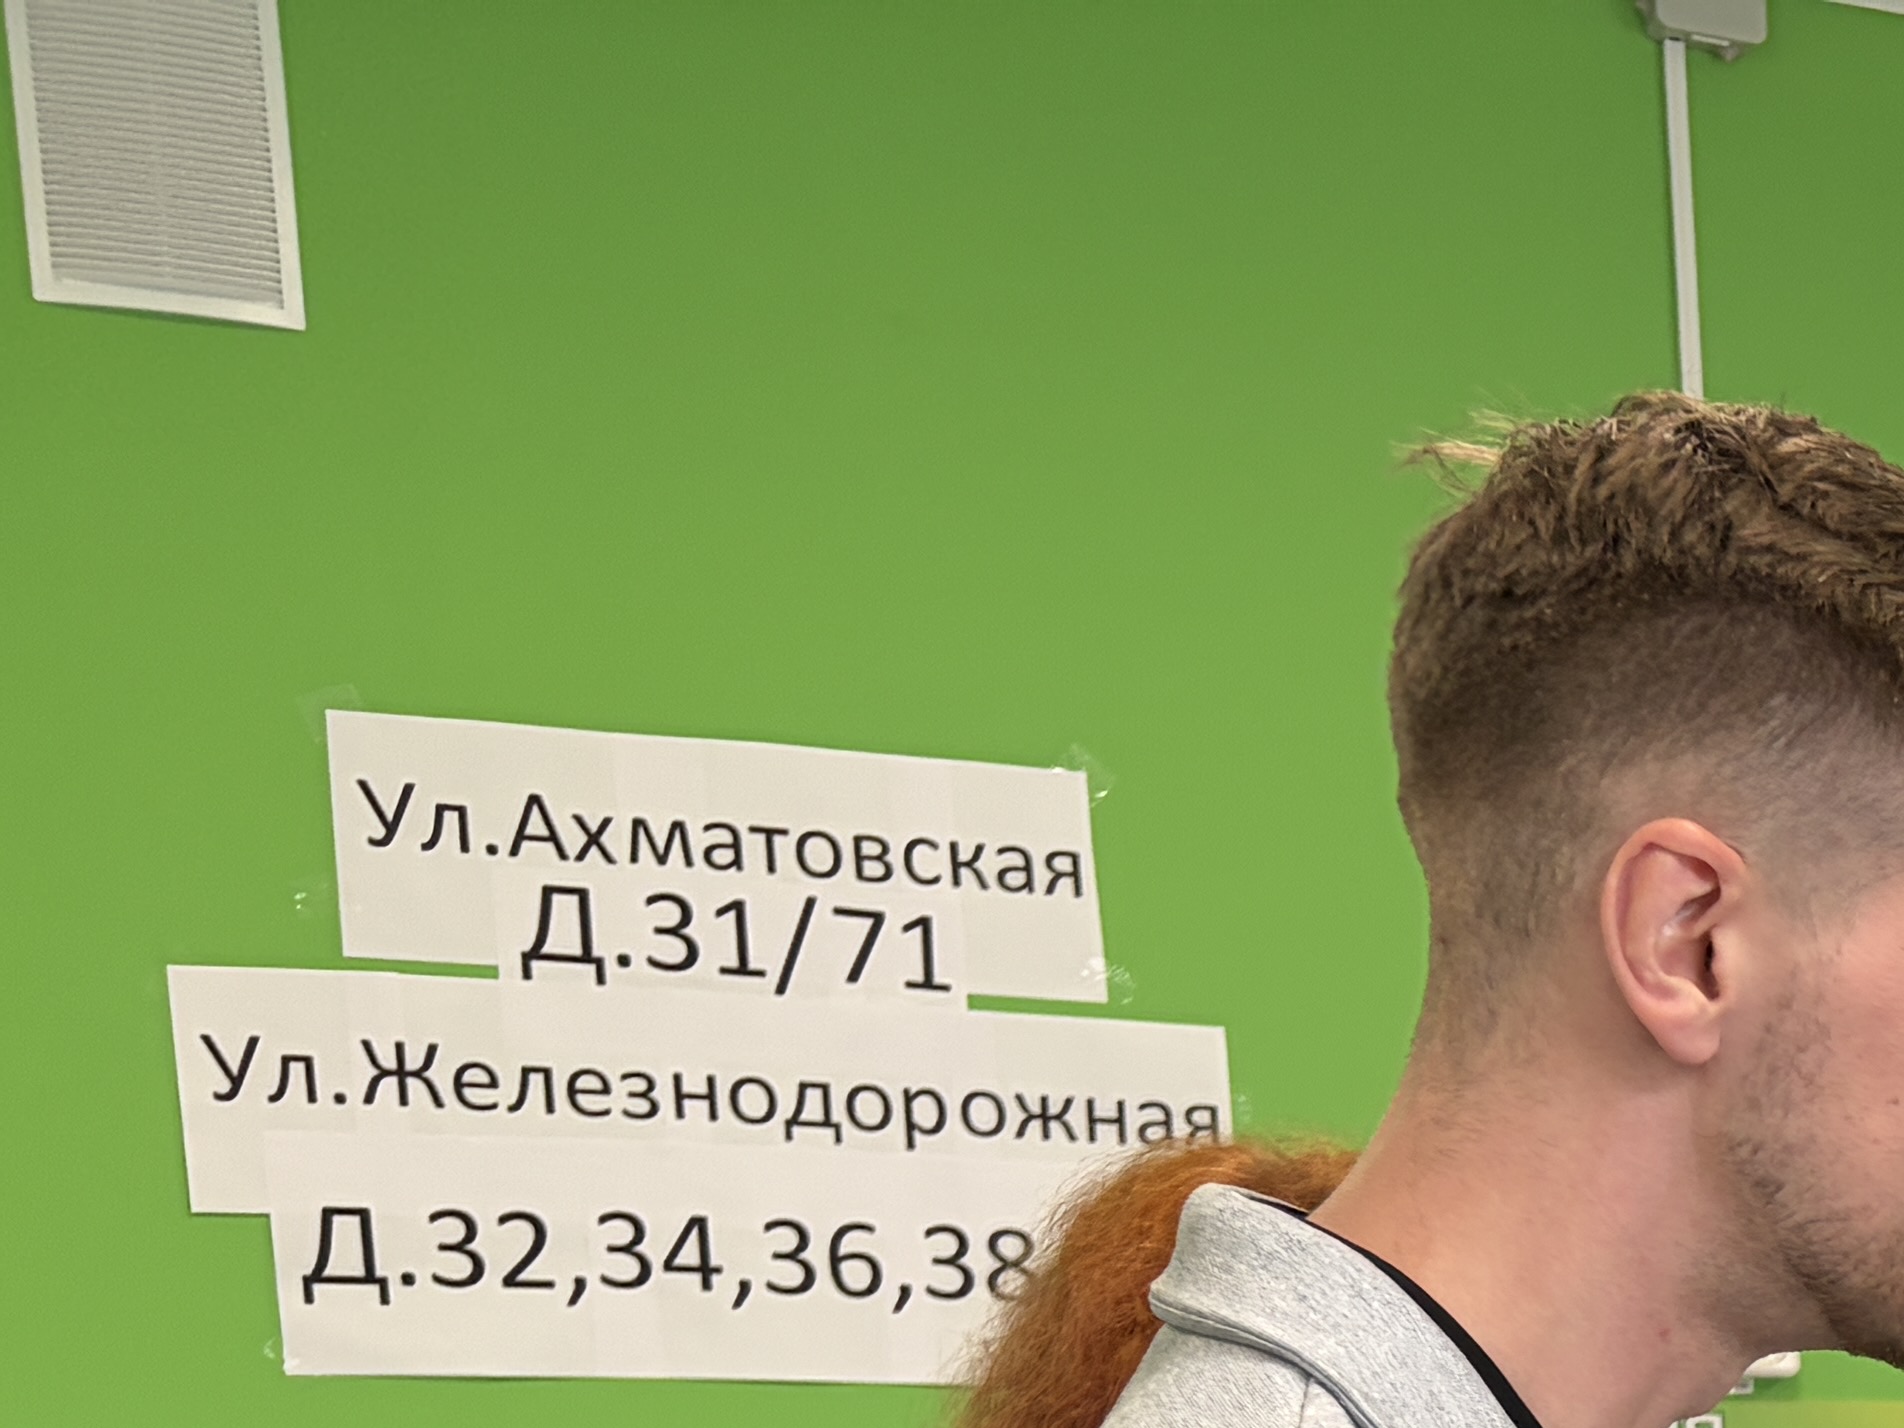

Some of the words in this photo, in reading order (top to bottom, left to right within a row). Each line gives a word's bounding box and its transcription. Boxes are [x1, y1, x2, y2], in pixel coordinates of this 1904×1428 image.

[357, 778, 1084, 898] Ул.Ахматовская
[520, 882, 953, 996] Д.31/71
[199, 1032, 1220, 1150] Ул.Железнодорожная
